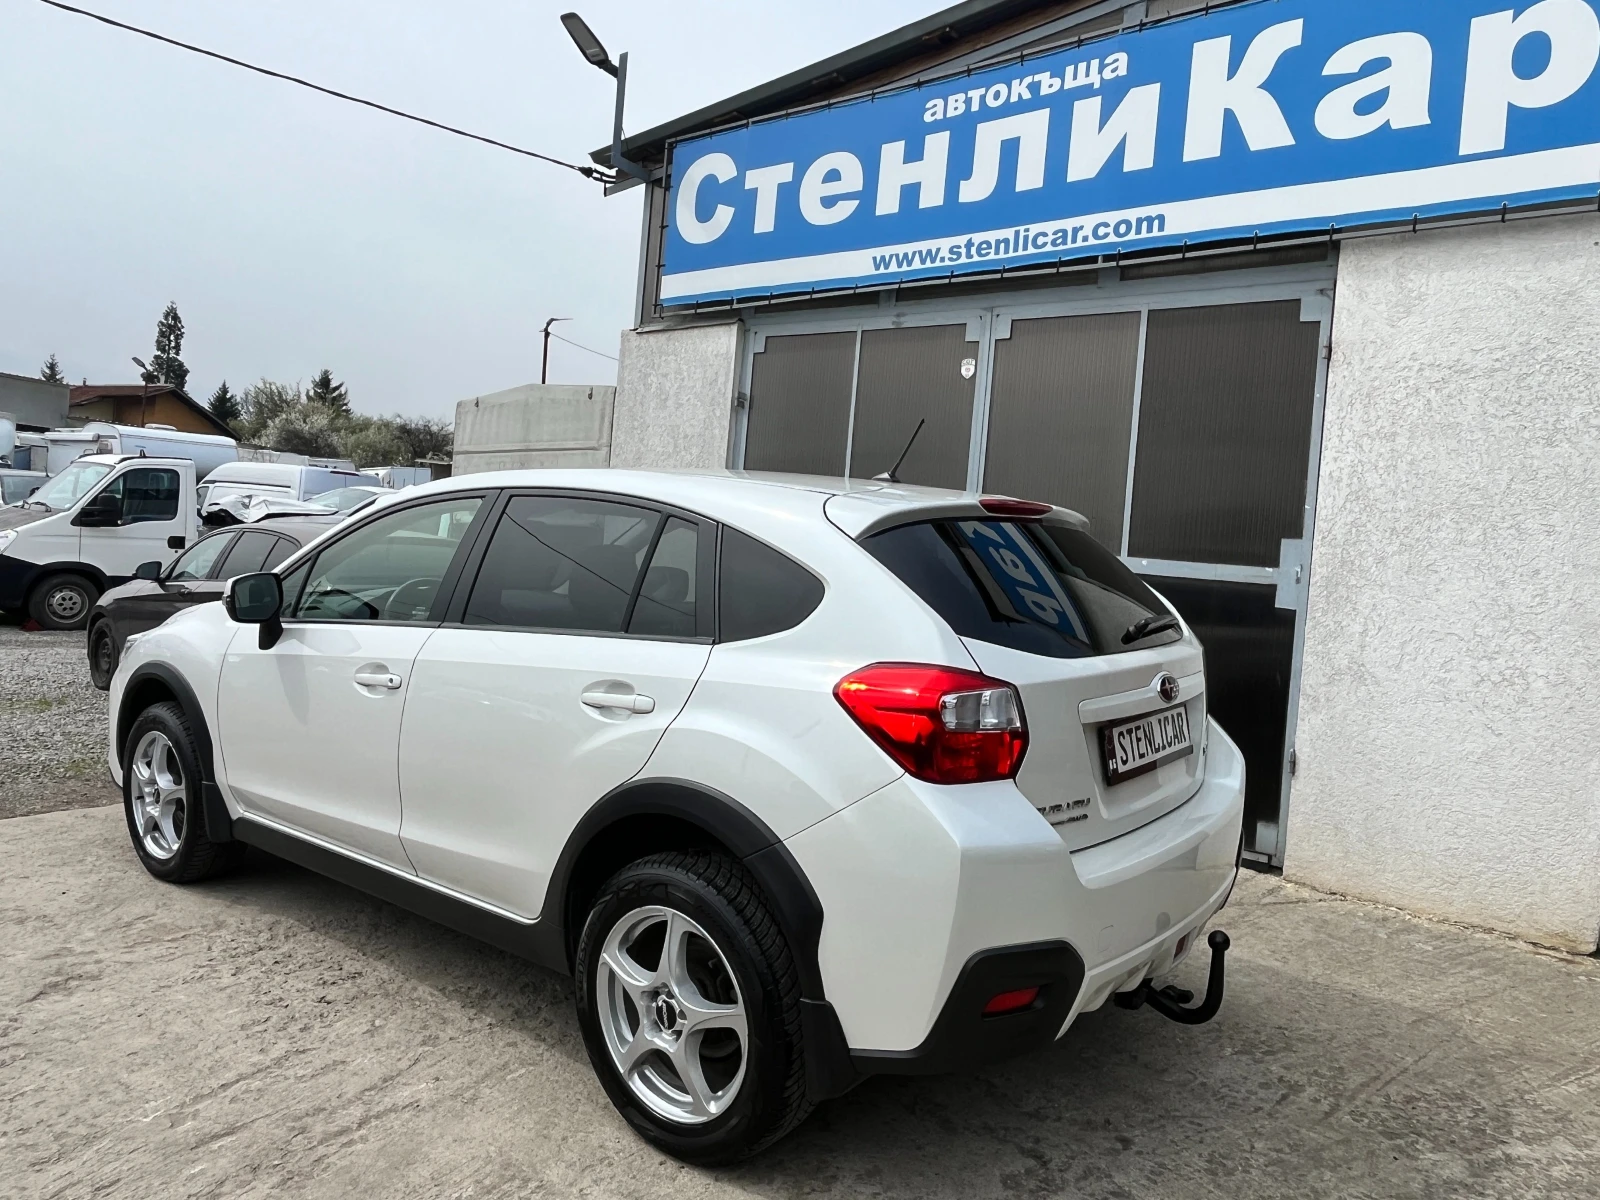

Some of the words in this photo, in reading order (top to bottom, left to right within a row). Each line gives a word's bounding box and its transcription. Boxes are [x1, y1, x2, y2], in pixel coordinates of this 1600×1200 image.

[923, 51, 1129, 124] автокъща
[675, 0, 1600, 245] СтенлиКар
[872, 210, 1166, 272] www.stenlicar.com
[1117, 711, 1187, 766] STENLICAR
